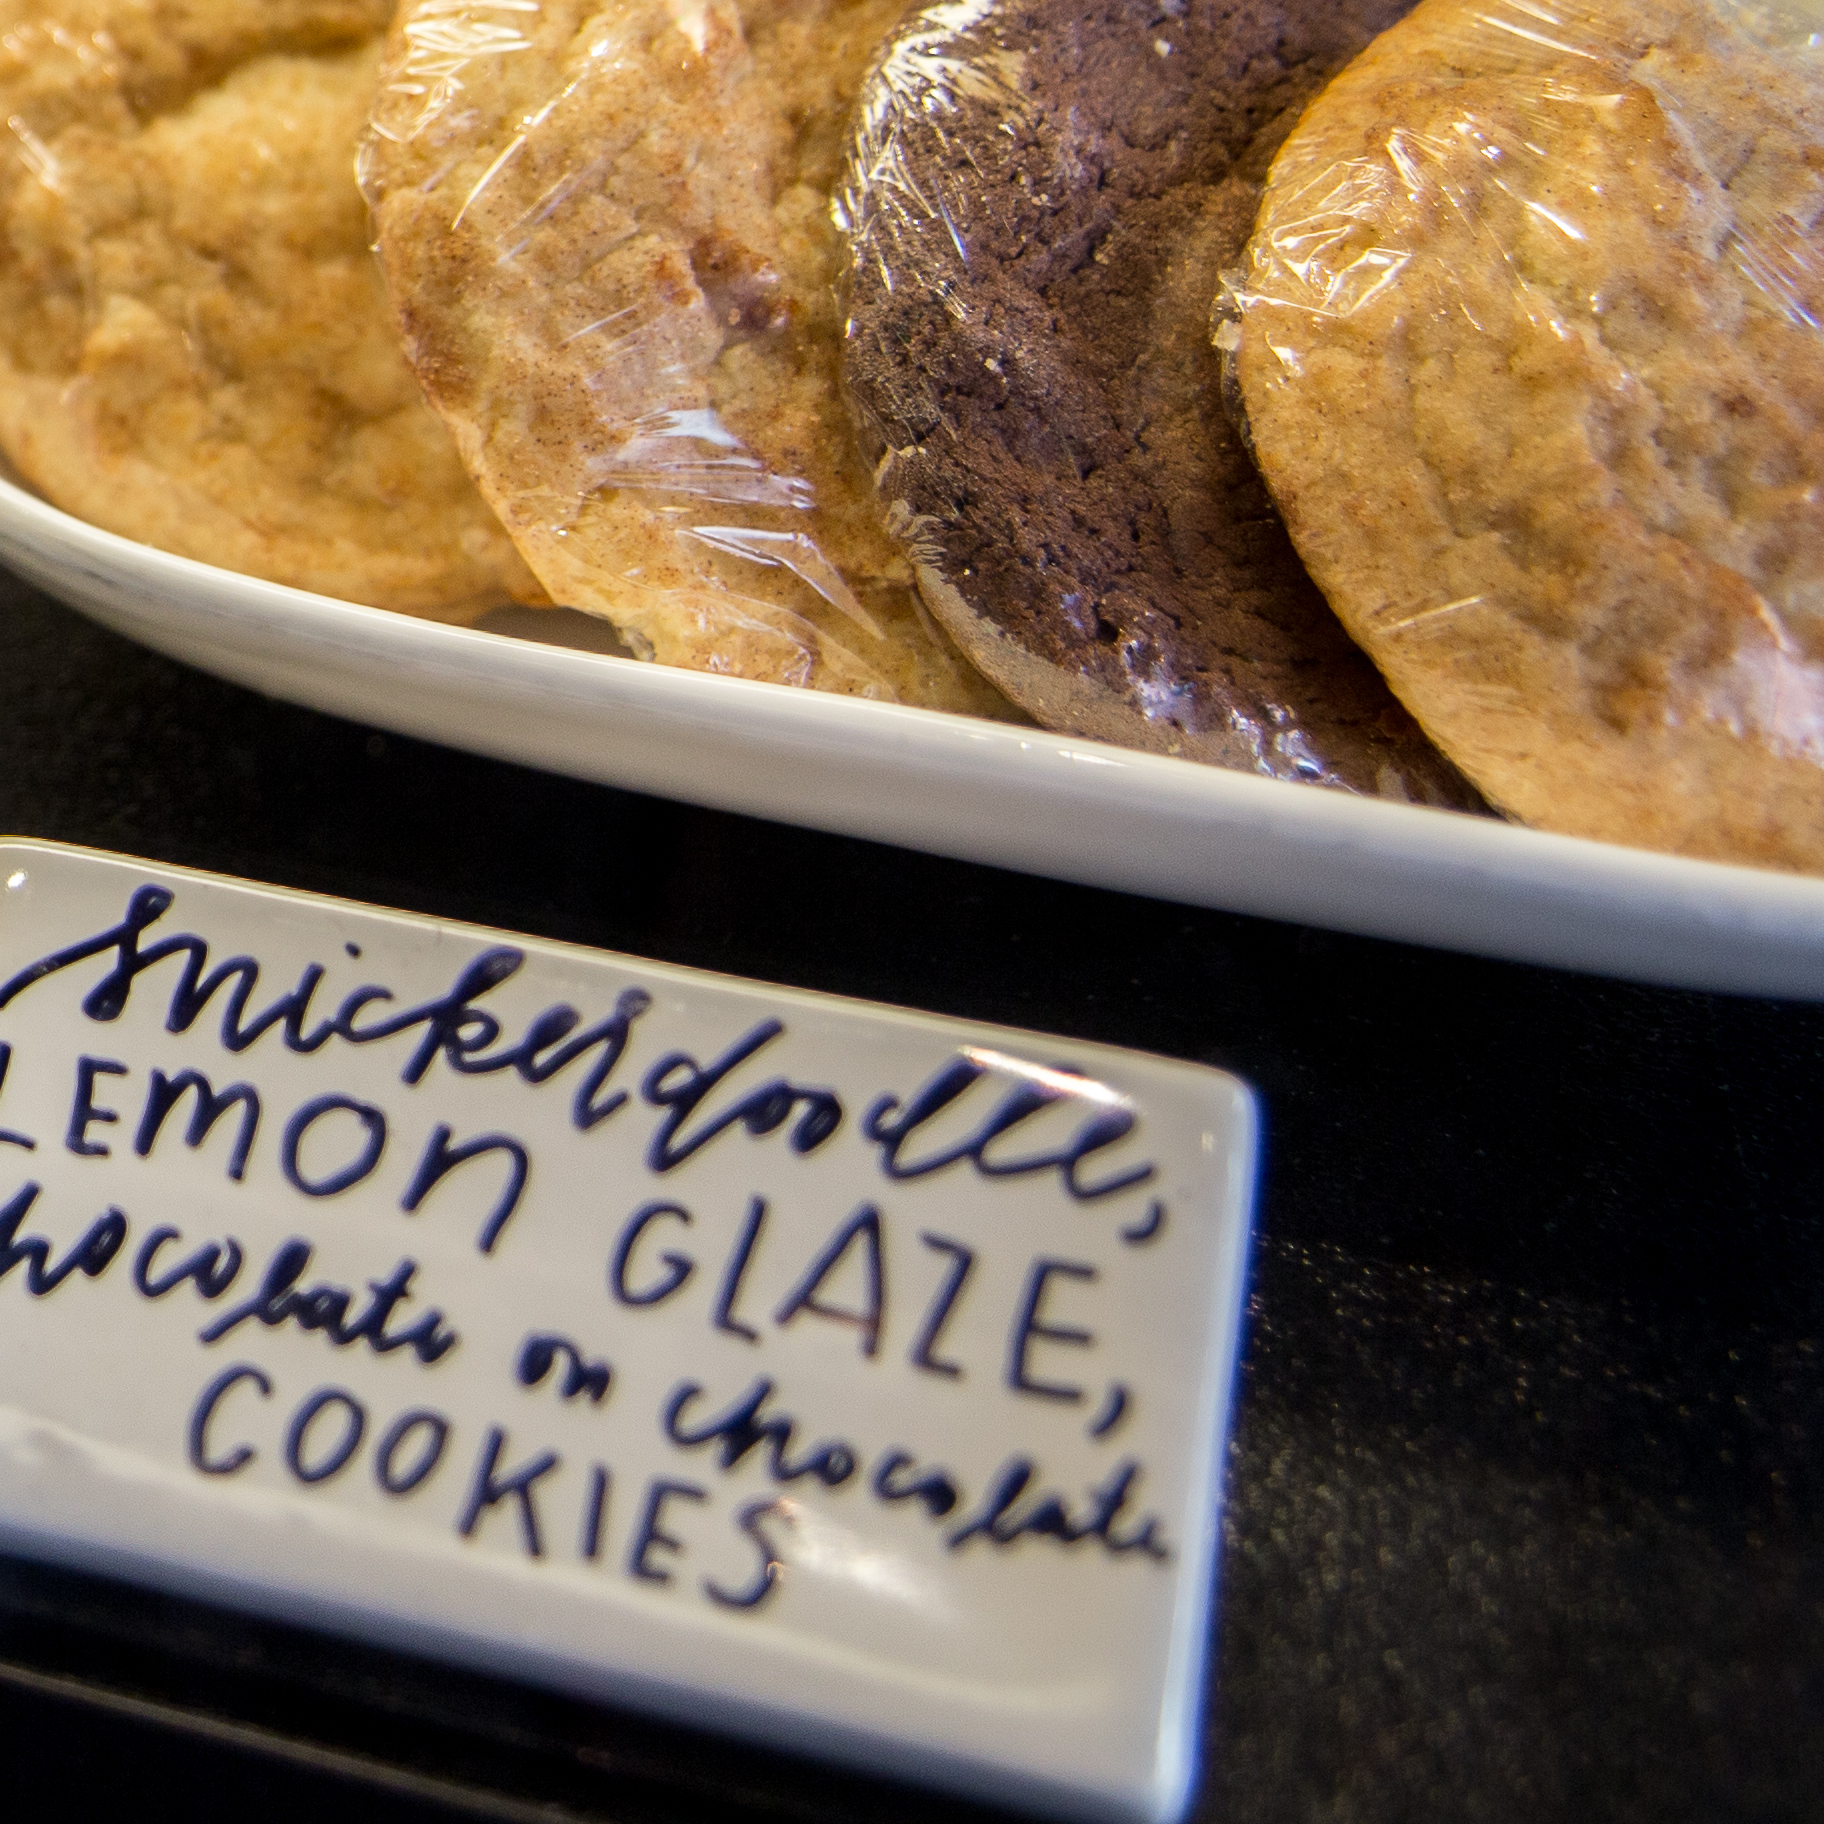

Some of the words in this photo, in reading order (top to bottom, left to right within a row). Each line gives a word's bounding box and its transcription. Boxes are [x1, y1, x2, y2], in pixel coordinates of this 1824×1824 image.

[610, 1196, 1133, 1442] GLAZE,
[188, 1365, 796, 1612] COOKIES
[515, 1333, 616, 1407] on
[663, 1378, 1176, 1570] chocolate
